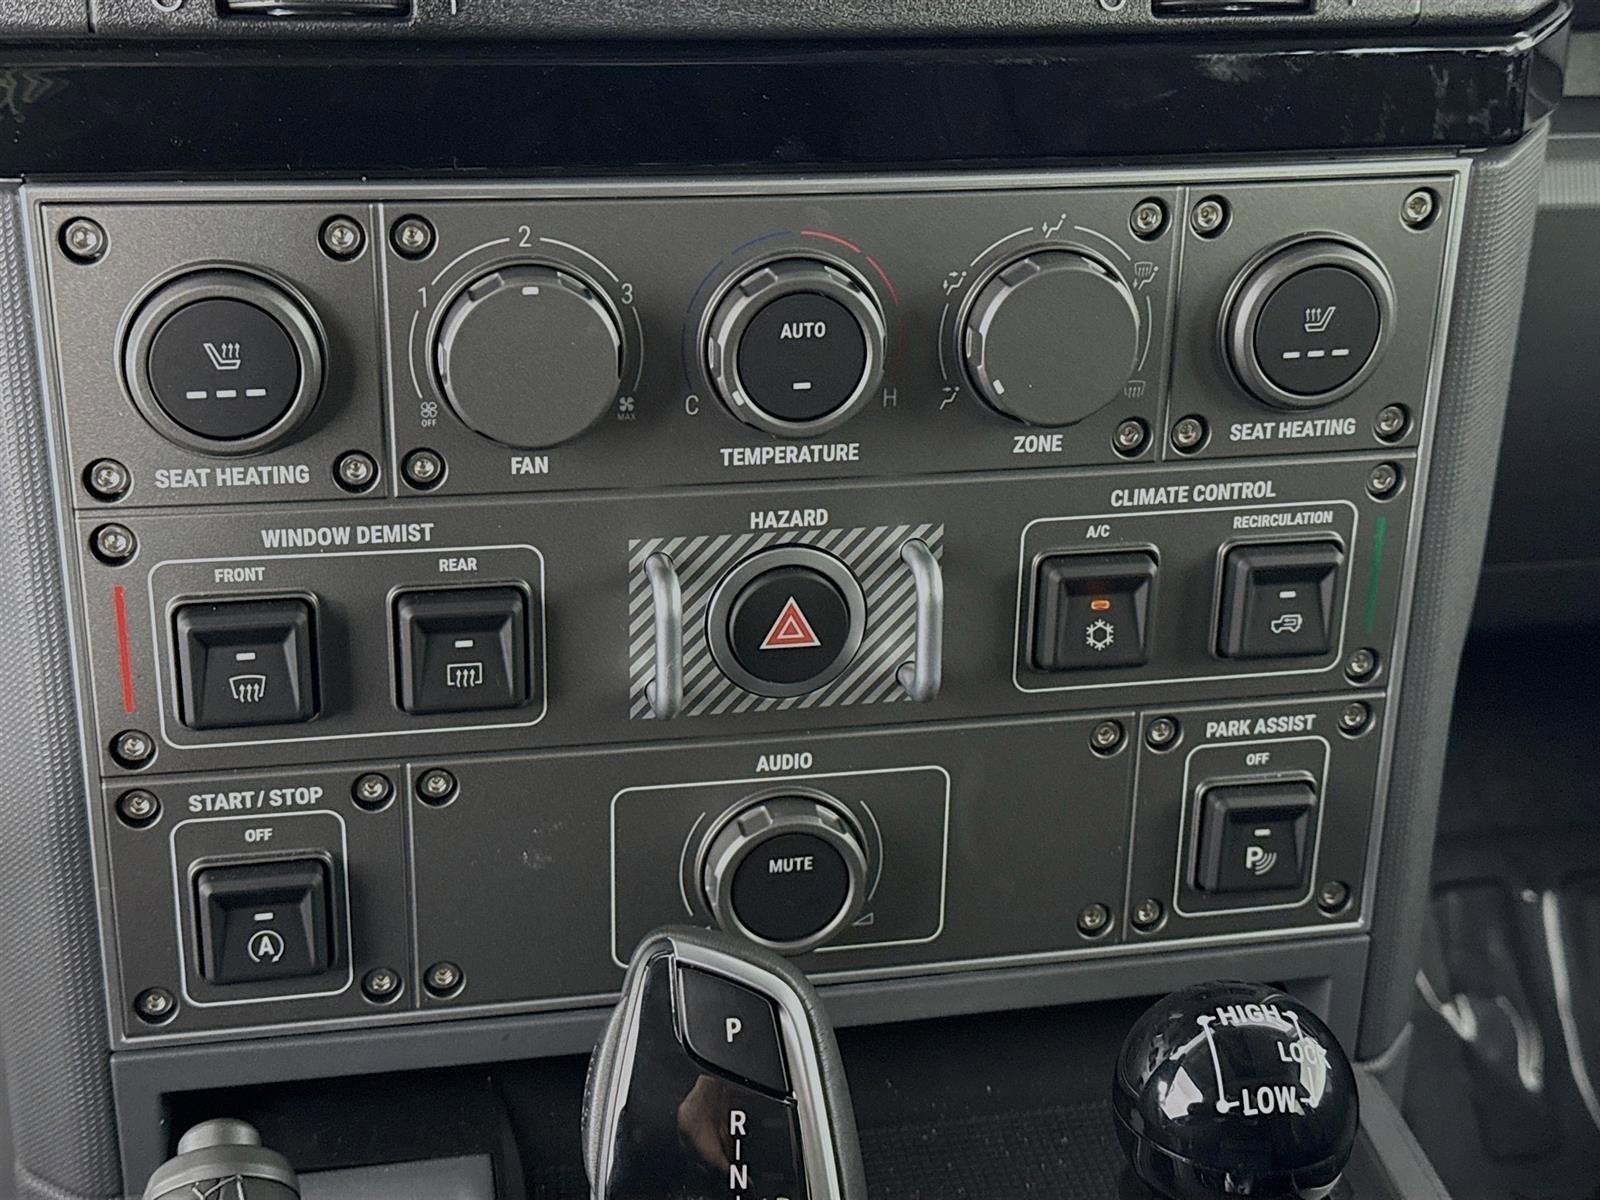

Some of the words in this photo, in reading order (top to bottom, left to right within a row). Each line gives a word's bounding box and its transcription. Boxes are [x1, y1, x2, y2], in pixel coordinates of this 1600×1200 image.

[518, 225, 532, 248] 2
[418, 287, 428, 307] 1
[621, 283, 634, 304] 3
[780, 321, 827, 340] AUTO
[685, 395, 700, 415] C
[883, 388, 897, 407] H
[421, 419, 437, 428] OFF
[1229, 422, 1273, 443] SEAT
[1279, 417, 1356, 440] HEATING
[719, 443, 860, 467] TEMPERATURE
[1012, 434, 1063, 455] ZONE
[511, 456, 549, 475] FAN
[155, 468, 209, 489] SEAT
[216, 465, 310, 487] HEATING
[1110, 486, 1189, 508] CLIMATE
[1193, 480, 1277, 503] CONTROL
[750, 508, 829, 530] HAZARD
[1232, 510, 1334, 530] RECIRCULATION
[261, 526, 351, 549] WINDOW
[356, 522, 434, 545] DEMIST
[1086, 524, 1111, 539] A/C
[214, 567, 266, 583] FRONT
[438, 557, 478, 573] REAR
[1206, 719, 1250, 738] PARK
[1253, 713, 1317, 735] ASSIST
[755, 751, 813, 773] AUDIO
[1246, 752, 1270, 766] OFF
[188, 790, 254, 812] START
[268, 786, 324, 807] STOP
[244, 828, 273, 843] OFF
[768, 856, 814, 874] MUTE
[1215, 1003, 1281, 1027] HIGH
[725, 1017, 742, 1043] P
[1276, 1041, 1331, 1069] LOC
[1242, 1086, 1296, 1117] LOW
